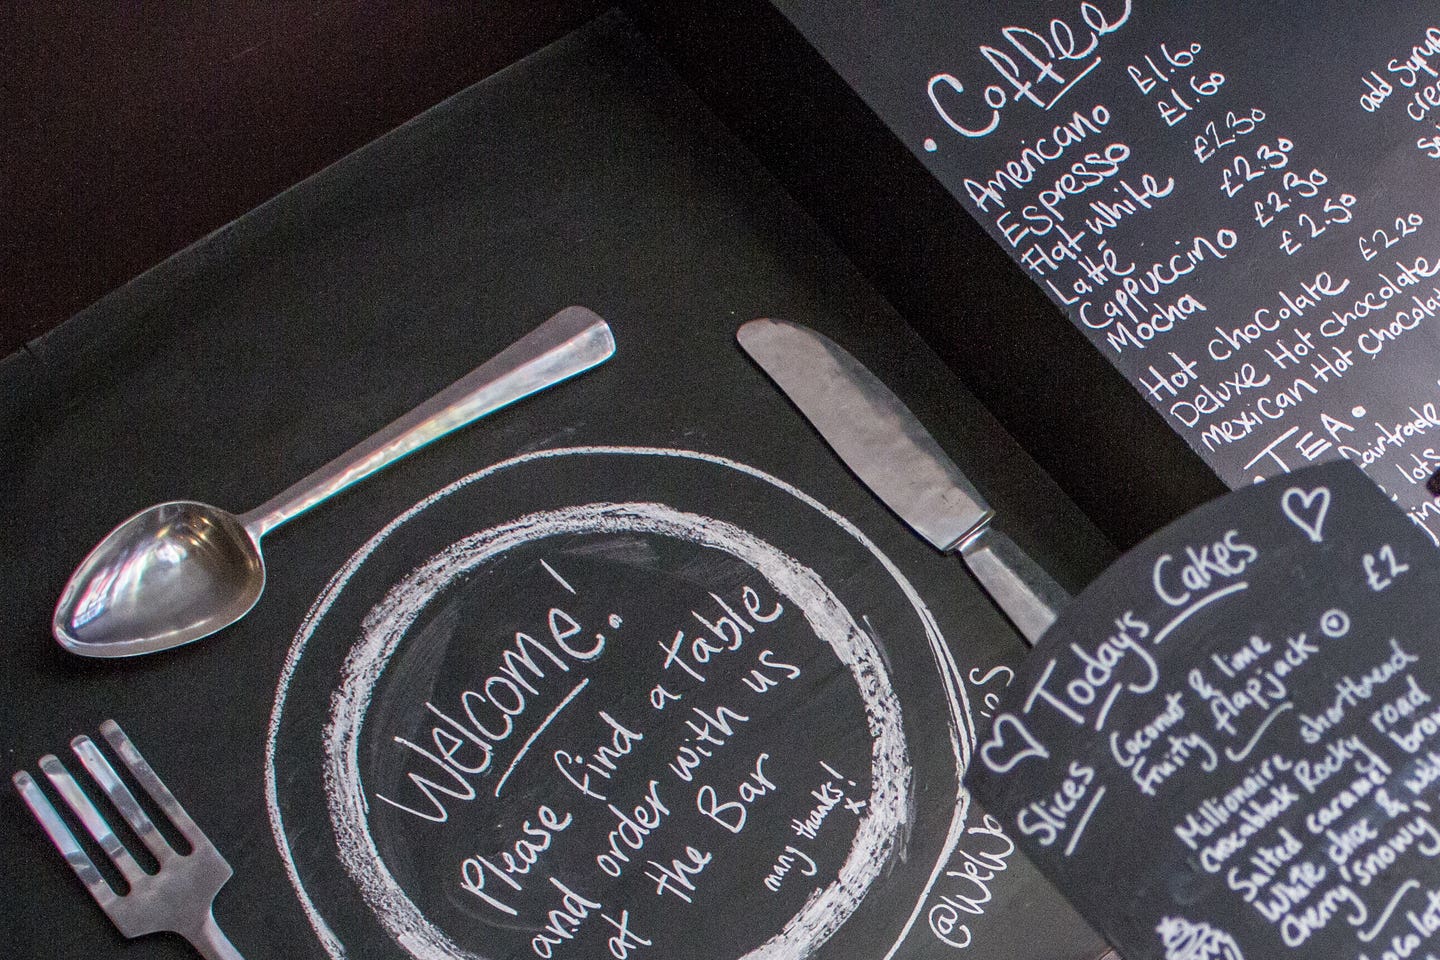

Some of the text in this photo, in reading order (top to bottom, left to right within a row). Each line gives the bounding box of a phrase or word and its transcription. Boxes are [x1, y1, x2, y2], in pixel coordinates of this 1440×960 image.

[963, 42, 1202, 213] Americano £1.60
[1360, 71, 1391, 113] add
[996, 71, 1226, 246] Espresso £1.60
[1193, 107, 1266, 163] £2.30
[1221, 138, 1294, 199] £2.30
[1080, 169, 1328, 330] Cappuccino £2.30
[1107, 193, 1357, 361] Mocha £2.50
[1138, 353, 1198, 404] Hot
[1171, 362, 1269, 428] Deluxe
[1273, 330, 1316, 380] Hot
[1313, 341, 1353, 383] Hot
[1153, 530, 1258, 606] Cakes
[1363, 544, 1410, 591] £2
[1213, 636, 1272, 680] lime
[1371, 676, 1431, 735] road
[460, 803, 572, 915] Please
[554, 711, 643, 801] find
[650, 684, 681, 709] a
[533, 650, 801, 958] and order with us
[1017, 761, 1095, 846] Slices
[602, 753, 782, 960] at the Bar
[764, 846, 817, 891] many
[1228, 829, 1302, 902] Salted
